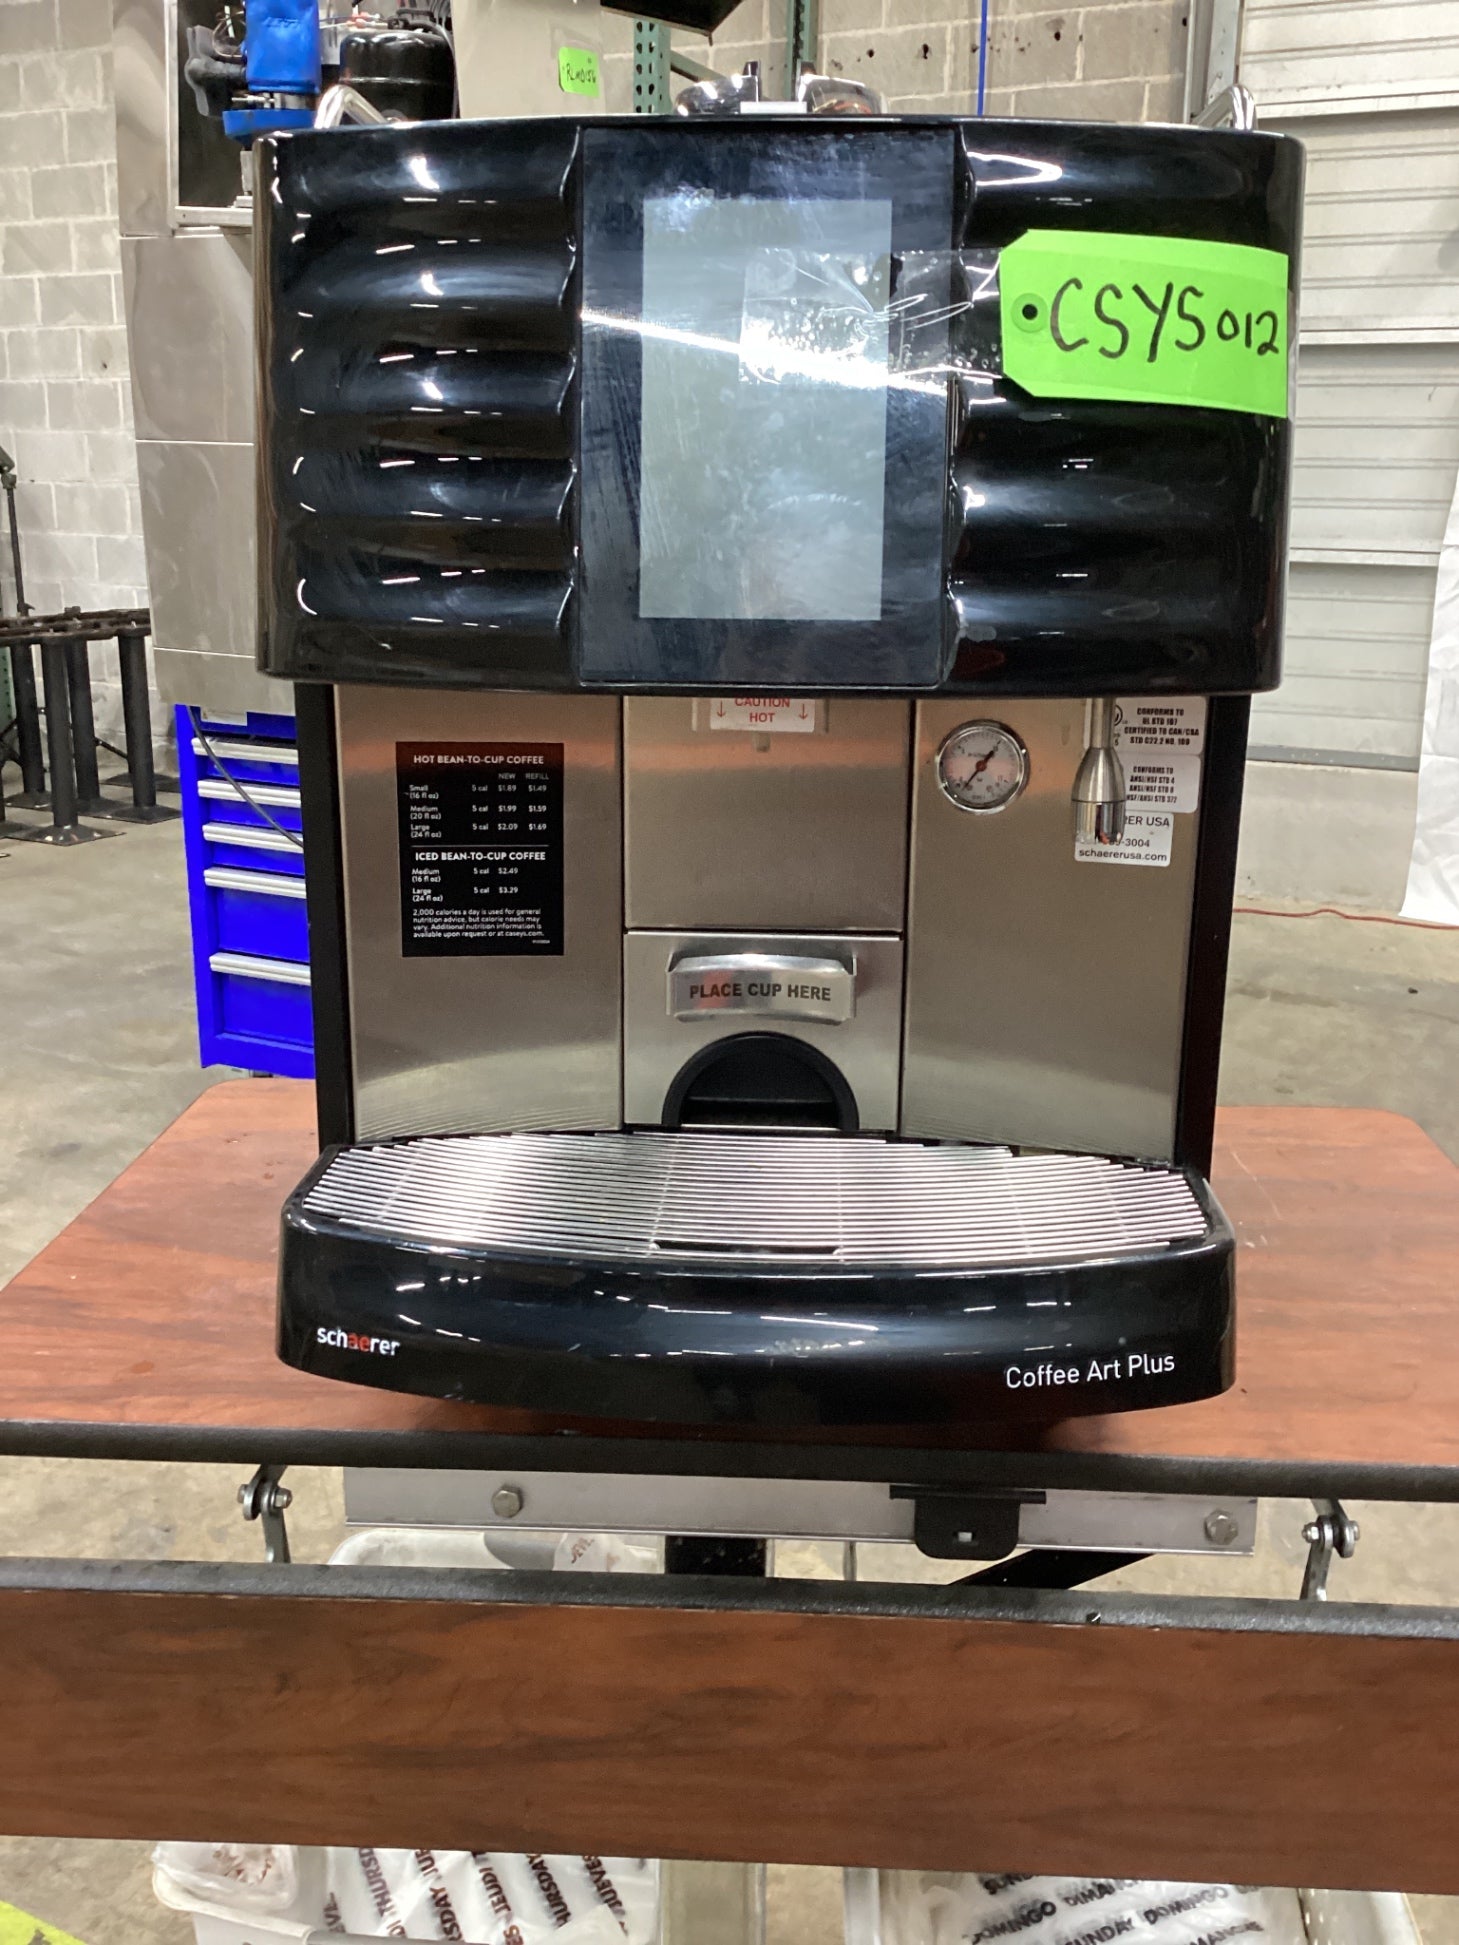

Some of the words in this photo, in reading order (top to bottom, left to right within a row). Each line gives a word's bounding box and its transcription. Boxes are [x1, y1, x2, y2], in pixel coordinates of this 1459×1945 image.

[734, 698, 791, 708] CAUTION
[1137, 707, 1174, 716] CONFORMS
[749, 713, 775, 722] HOT
[1124, 727, 1157, 735] CERTIFIED
[414, 755, 435, 764] HOT
[437, 755, 504, 764] BEAN-TO-CUP
[506, 756, 544, 764] COFFEE
[1133, 766, 1165, 774] CONFORMS
[1130, 776, 1158, 784] ANSI/NSF
[1159, 776, 1170, 784] STD
[472, 784, 476, 792] 5
[1154, 795, 1166, 803] STD
[1146, 816, 1170, 827] USA
[415, 852, 439, 861] ICED
[441, 852, 507, 861] BEAN-TO-CUP
[509, 852, 546, 861] COFFEE
[1079, 848, 1167, 862] schaererusa.com
[690, 983, 742, 999] PLACE
[748, 983, 782, 997] CUP
[787, 984, 831, 1001] HERE
[317, 1327, 400, 1356] schaerer
[1006, 1364, 1080, 1389] Coffee
[1087, 1360, 1121, 1382] Art
[1128, 1354, 1175, 1377] Plus
